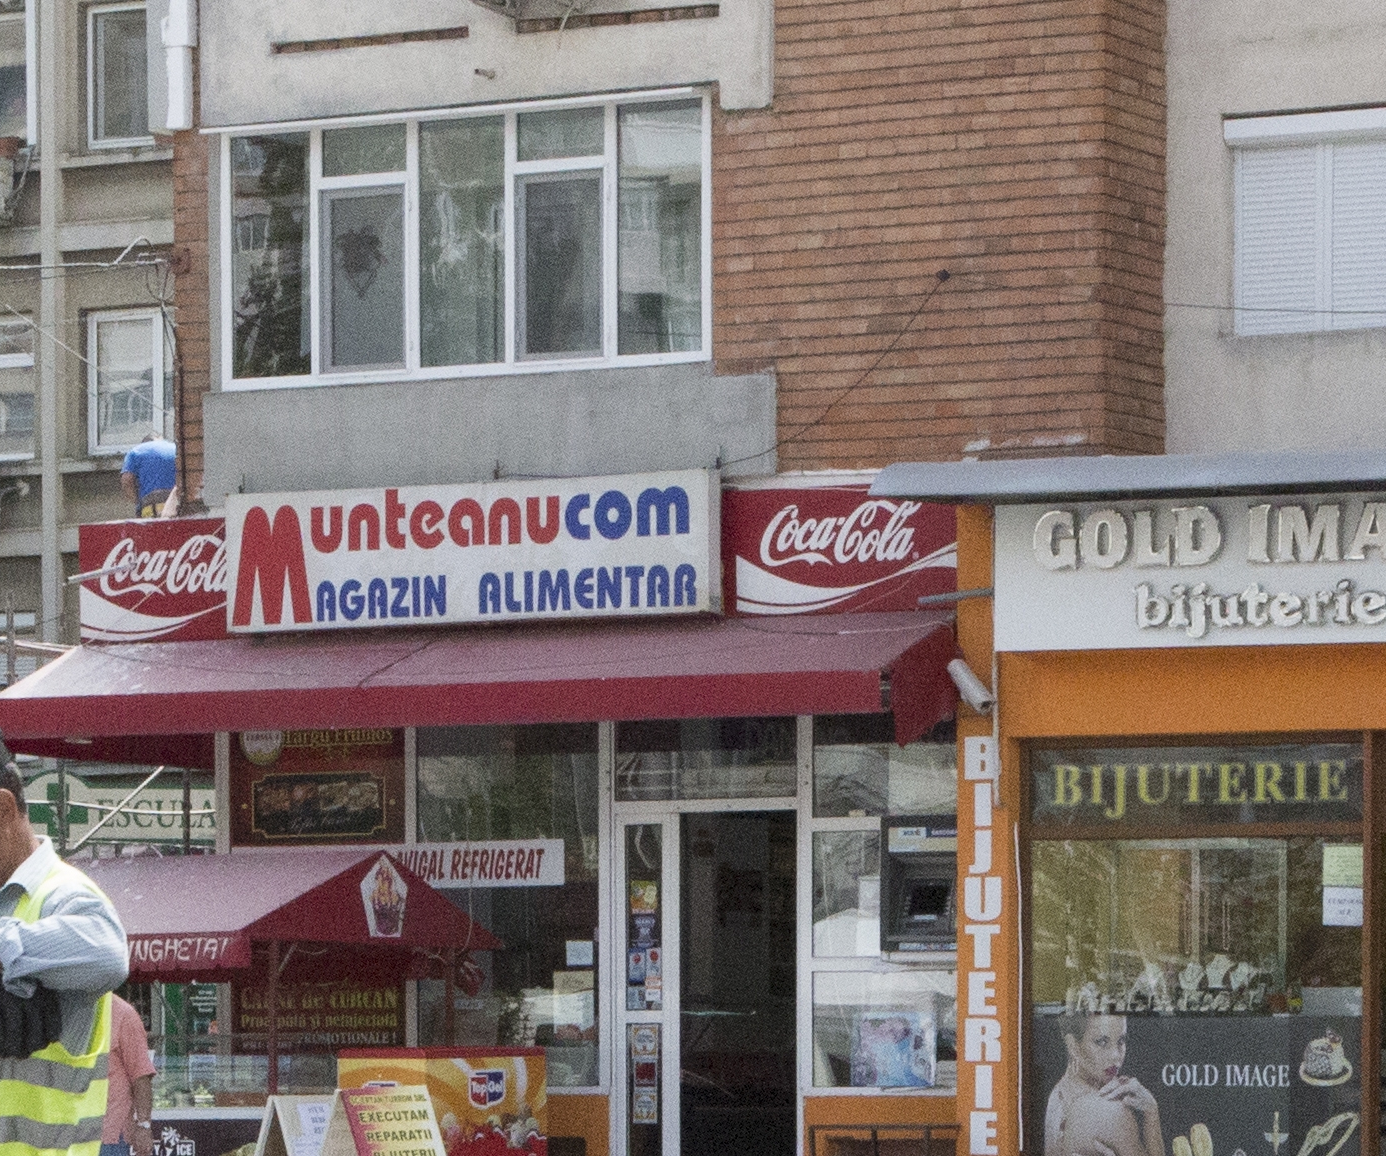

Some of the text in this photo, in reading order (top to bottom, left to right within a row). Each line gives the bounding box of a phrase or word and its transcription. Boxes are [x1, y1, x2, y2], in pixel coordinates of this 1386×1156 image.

[760, 500, 913, 567] Coca-Cola
[1032, 506, 1222, 571] GOLD
[479, 562, 698, 614] ALIMENTAR
[1052, 758, 1348, 818] BIJUTERIE
[450, 848, 544, 881] REFRIGERAT
[964, 736, 1002, 1156] BIJUTERIE
[1161, 1063, 1290, 1087] GOLD IMAGE
[359, 1110, 429, 1124] EXECUTAM
[366, 1129, 433, 1143] REPARATII
